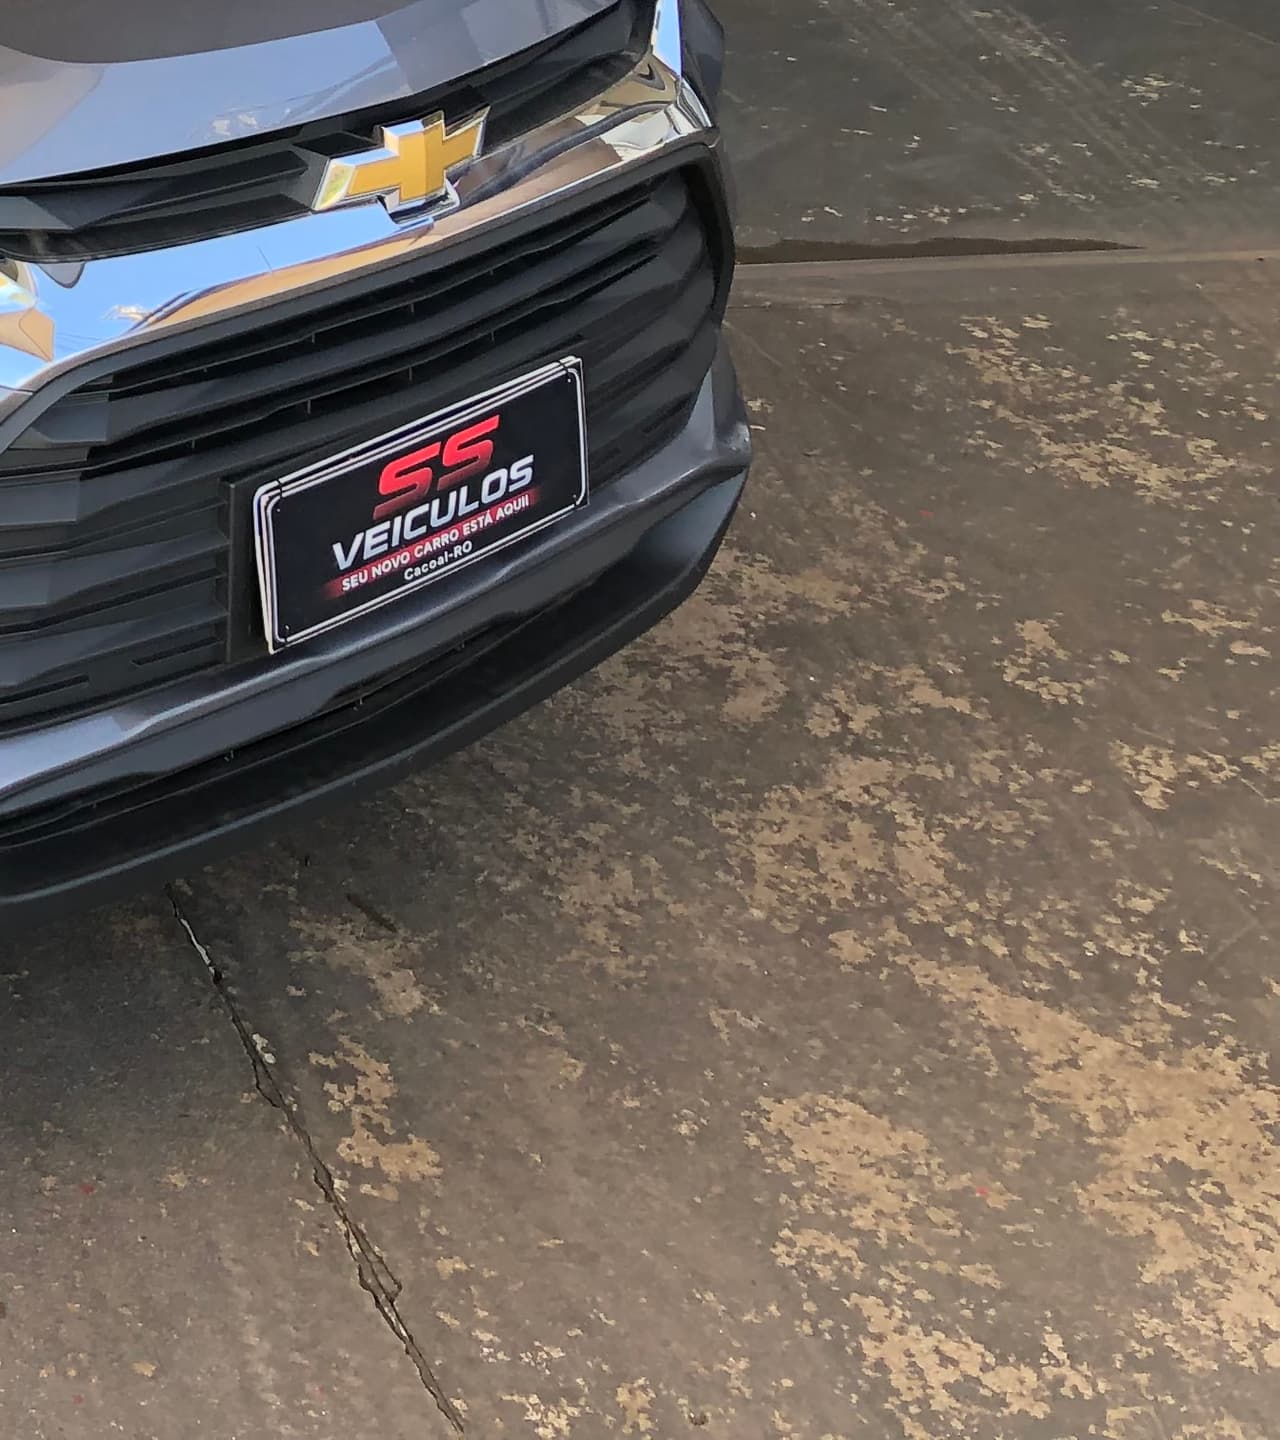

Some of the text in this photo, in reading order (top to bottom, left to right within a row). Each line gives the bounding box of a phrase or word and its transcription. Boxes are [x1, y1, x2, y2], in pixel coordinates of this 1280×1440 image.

[332, 454, 534, 570] VEICULOS
[373, 415, 500, 520] SS
[342, 571, 368, 591] SEU
[371, 551, 411, 578] NOVO
[414, 529, 460, 558] CARRO
[463, 510, 493, 536] ESTÁ
[404, 540, 473, 581] Cacoal-RO
